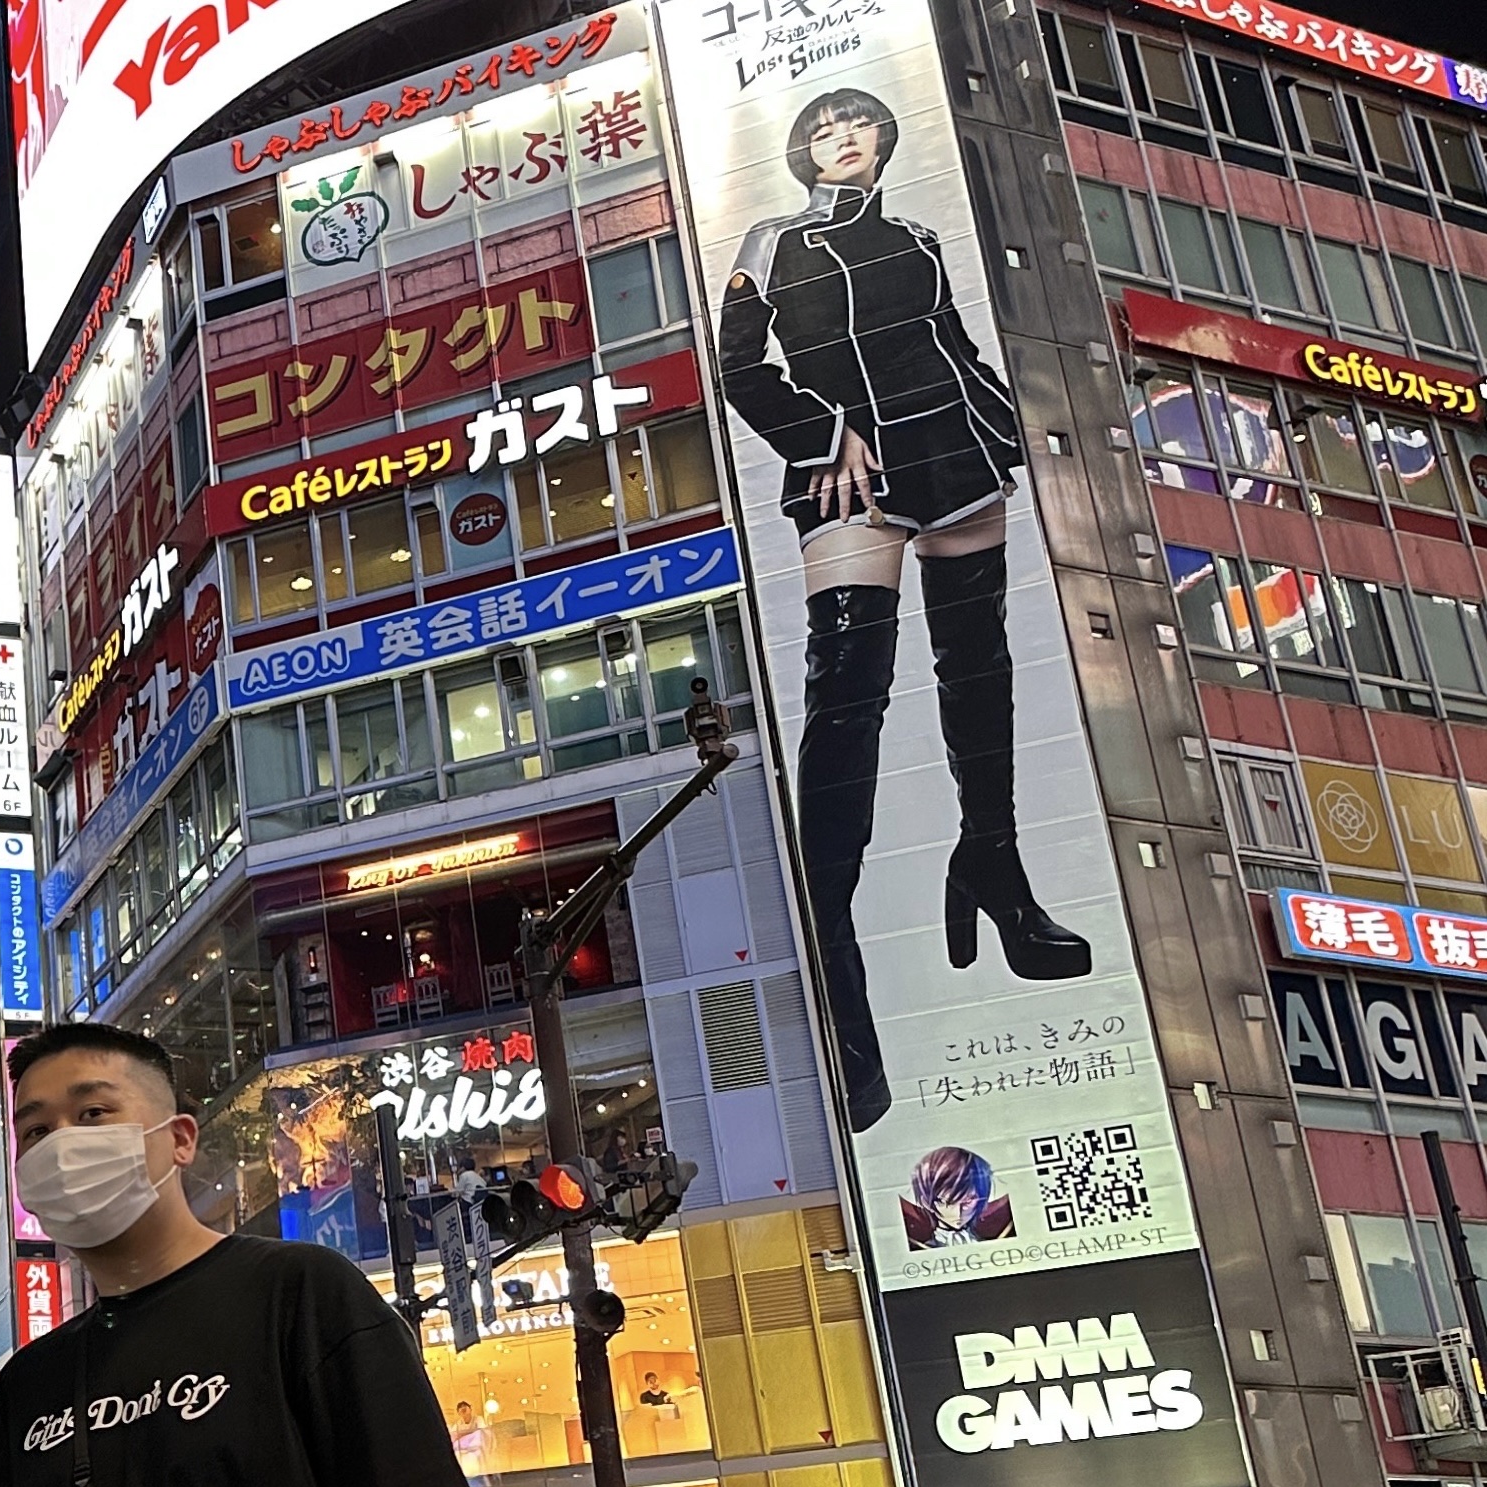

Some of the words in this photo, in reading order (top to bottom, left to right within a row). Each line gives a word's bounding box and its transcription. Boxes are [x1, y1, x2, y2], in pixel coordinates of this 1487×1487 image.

[762, 2, 885, 51] 反逆のルルーシュ
[788, 34, 862, 80] Stories
[1175, 0, 1438, 84] しゃぶバイキング
[231, 12, 617, 174] しゃぶしゃぶバイキング
[411, 90, 648, 220] しゃぶ葉
[214, 288, 580, 438] コンタクト
[1304, 344, 1477, 413] Caféレストラン
[240, 437, 452, 520] Caféレストラン
[466, 375, 649, 473] ガスト
[458, 513, 501, 534] ガスト
[120, 543, 179, 657] ガスト
[377, 545, 724, 664] 英会話イーオン
[243, 641, 350, 693] AEON
[3, 800, 22, 812] 6F
[1301, 901, 1399, 957] 薄毛
[380, 1032, 534, 1087] 渋谷焼肉
[945, 1015, 1125, 1062] これは、きみの
[918, 1046, 1136, 1108] 「失われた物語」
[954, 1312, 1156, 1390] DMM
[167, 1374, 231, 1420] Cry
[935, 1369, 1205, 1454] GAMES
